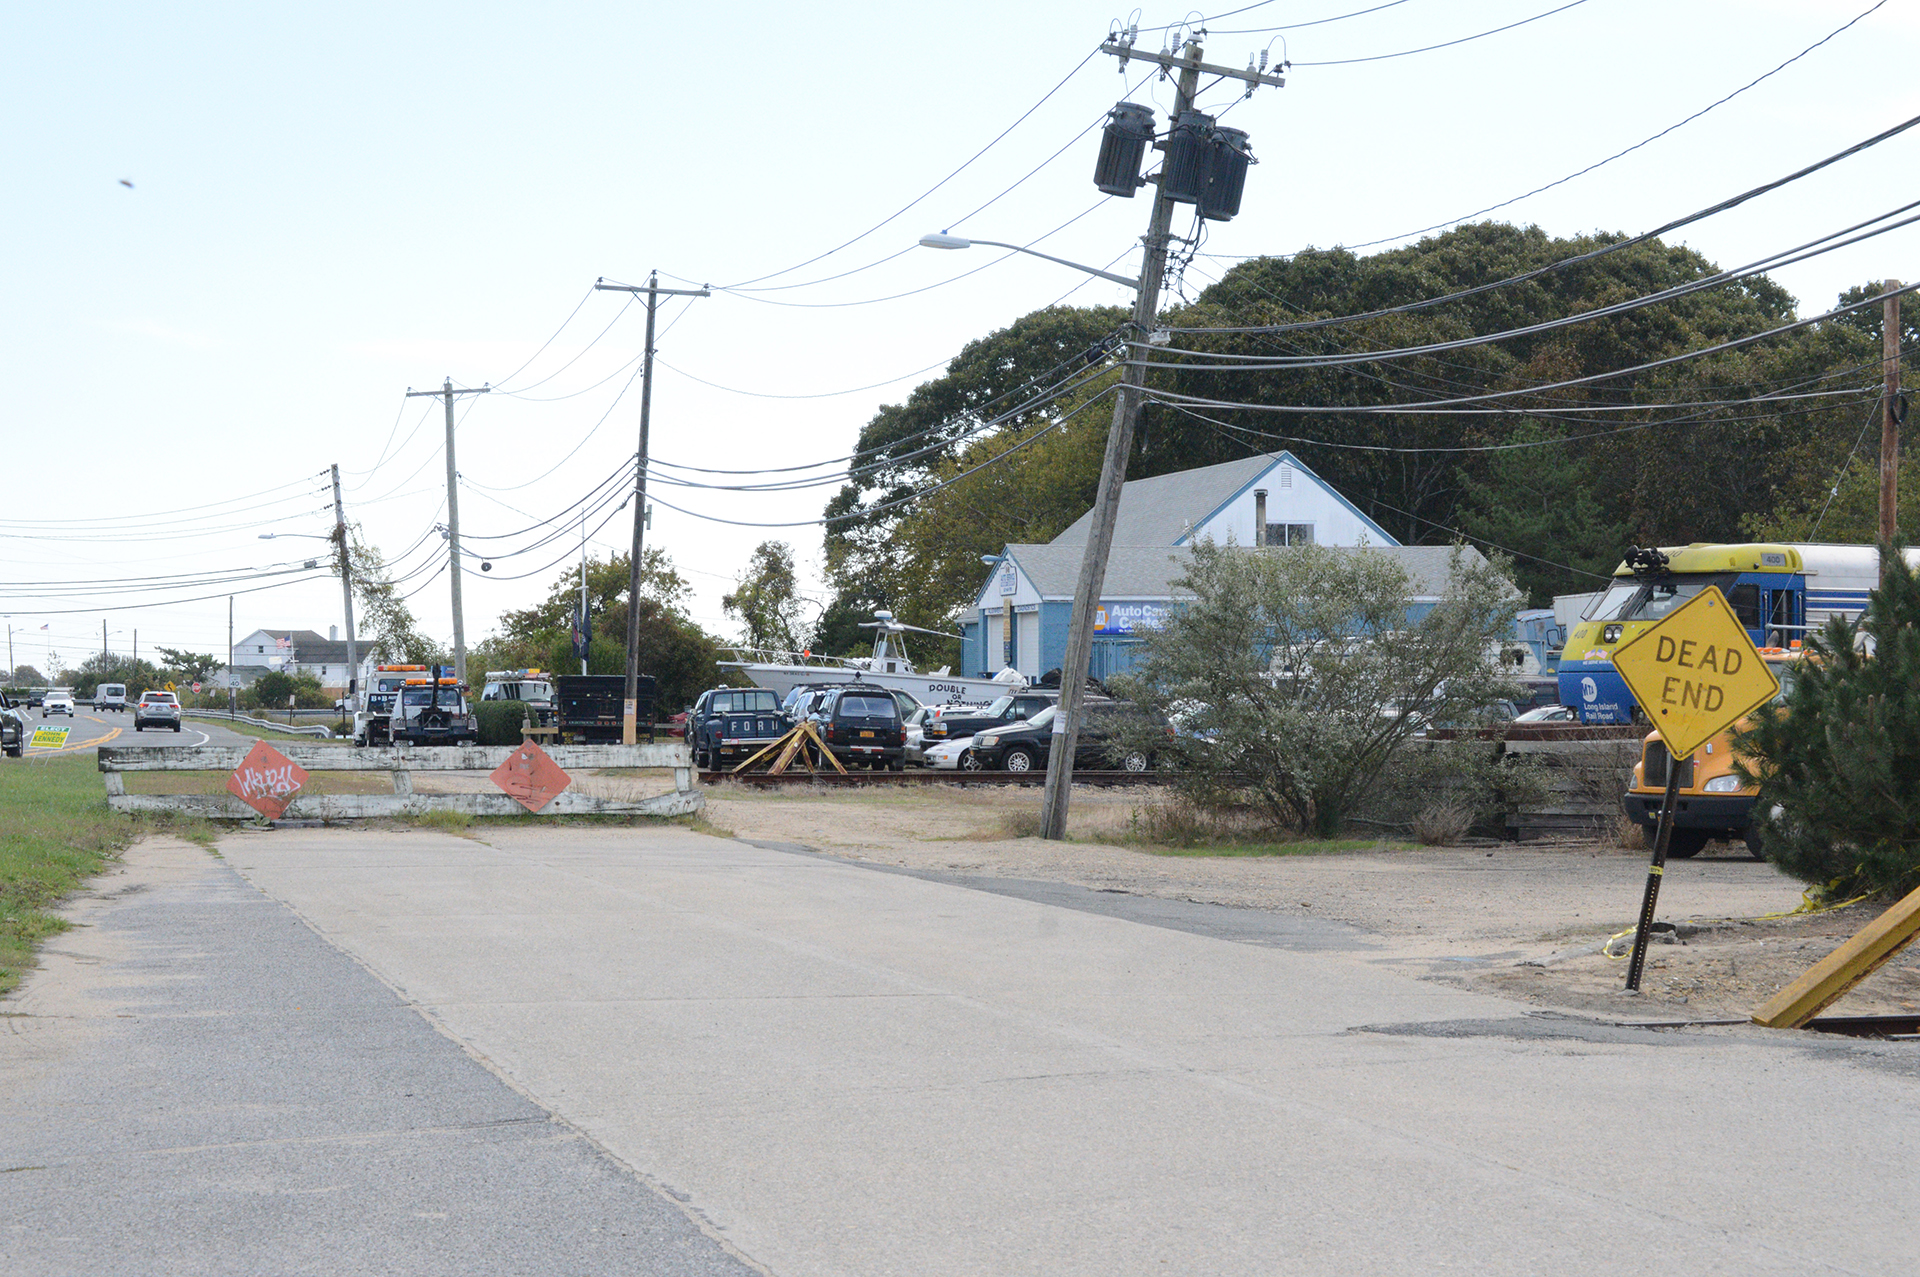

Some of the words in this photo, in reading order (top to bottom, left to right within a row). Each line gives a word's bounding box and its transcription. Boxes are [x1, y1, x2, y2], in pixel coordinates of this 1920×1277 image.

[1766, 555, 1781, 564] 400
[1119, 617, 1164, 629] Cente
[1574, 629, 1588, 639] 400
[1656, 635, 1742, 675] DEAD
[929, 684, 967, 694] DOUBLE
[1661, 676, 1724, 712] END
[1584, 703, 1598, 711] Long
[1598, 702, 1619, 710] Island
[1585, 712, 1597, 720] Rail
[1597, 712, 1614, 720] Road
[731, 721, 778, 731] FORD
[33, 735, 66, 743] KENNEDY
